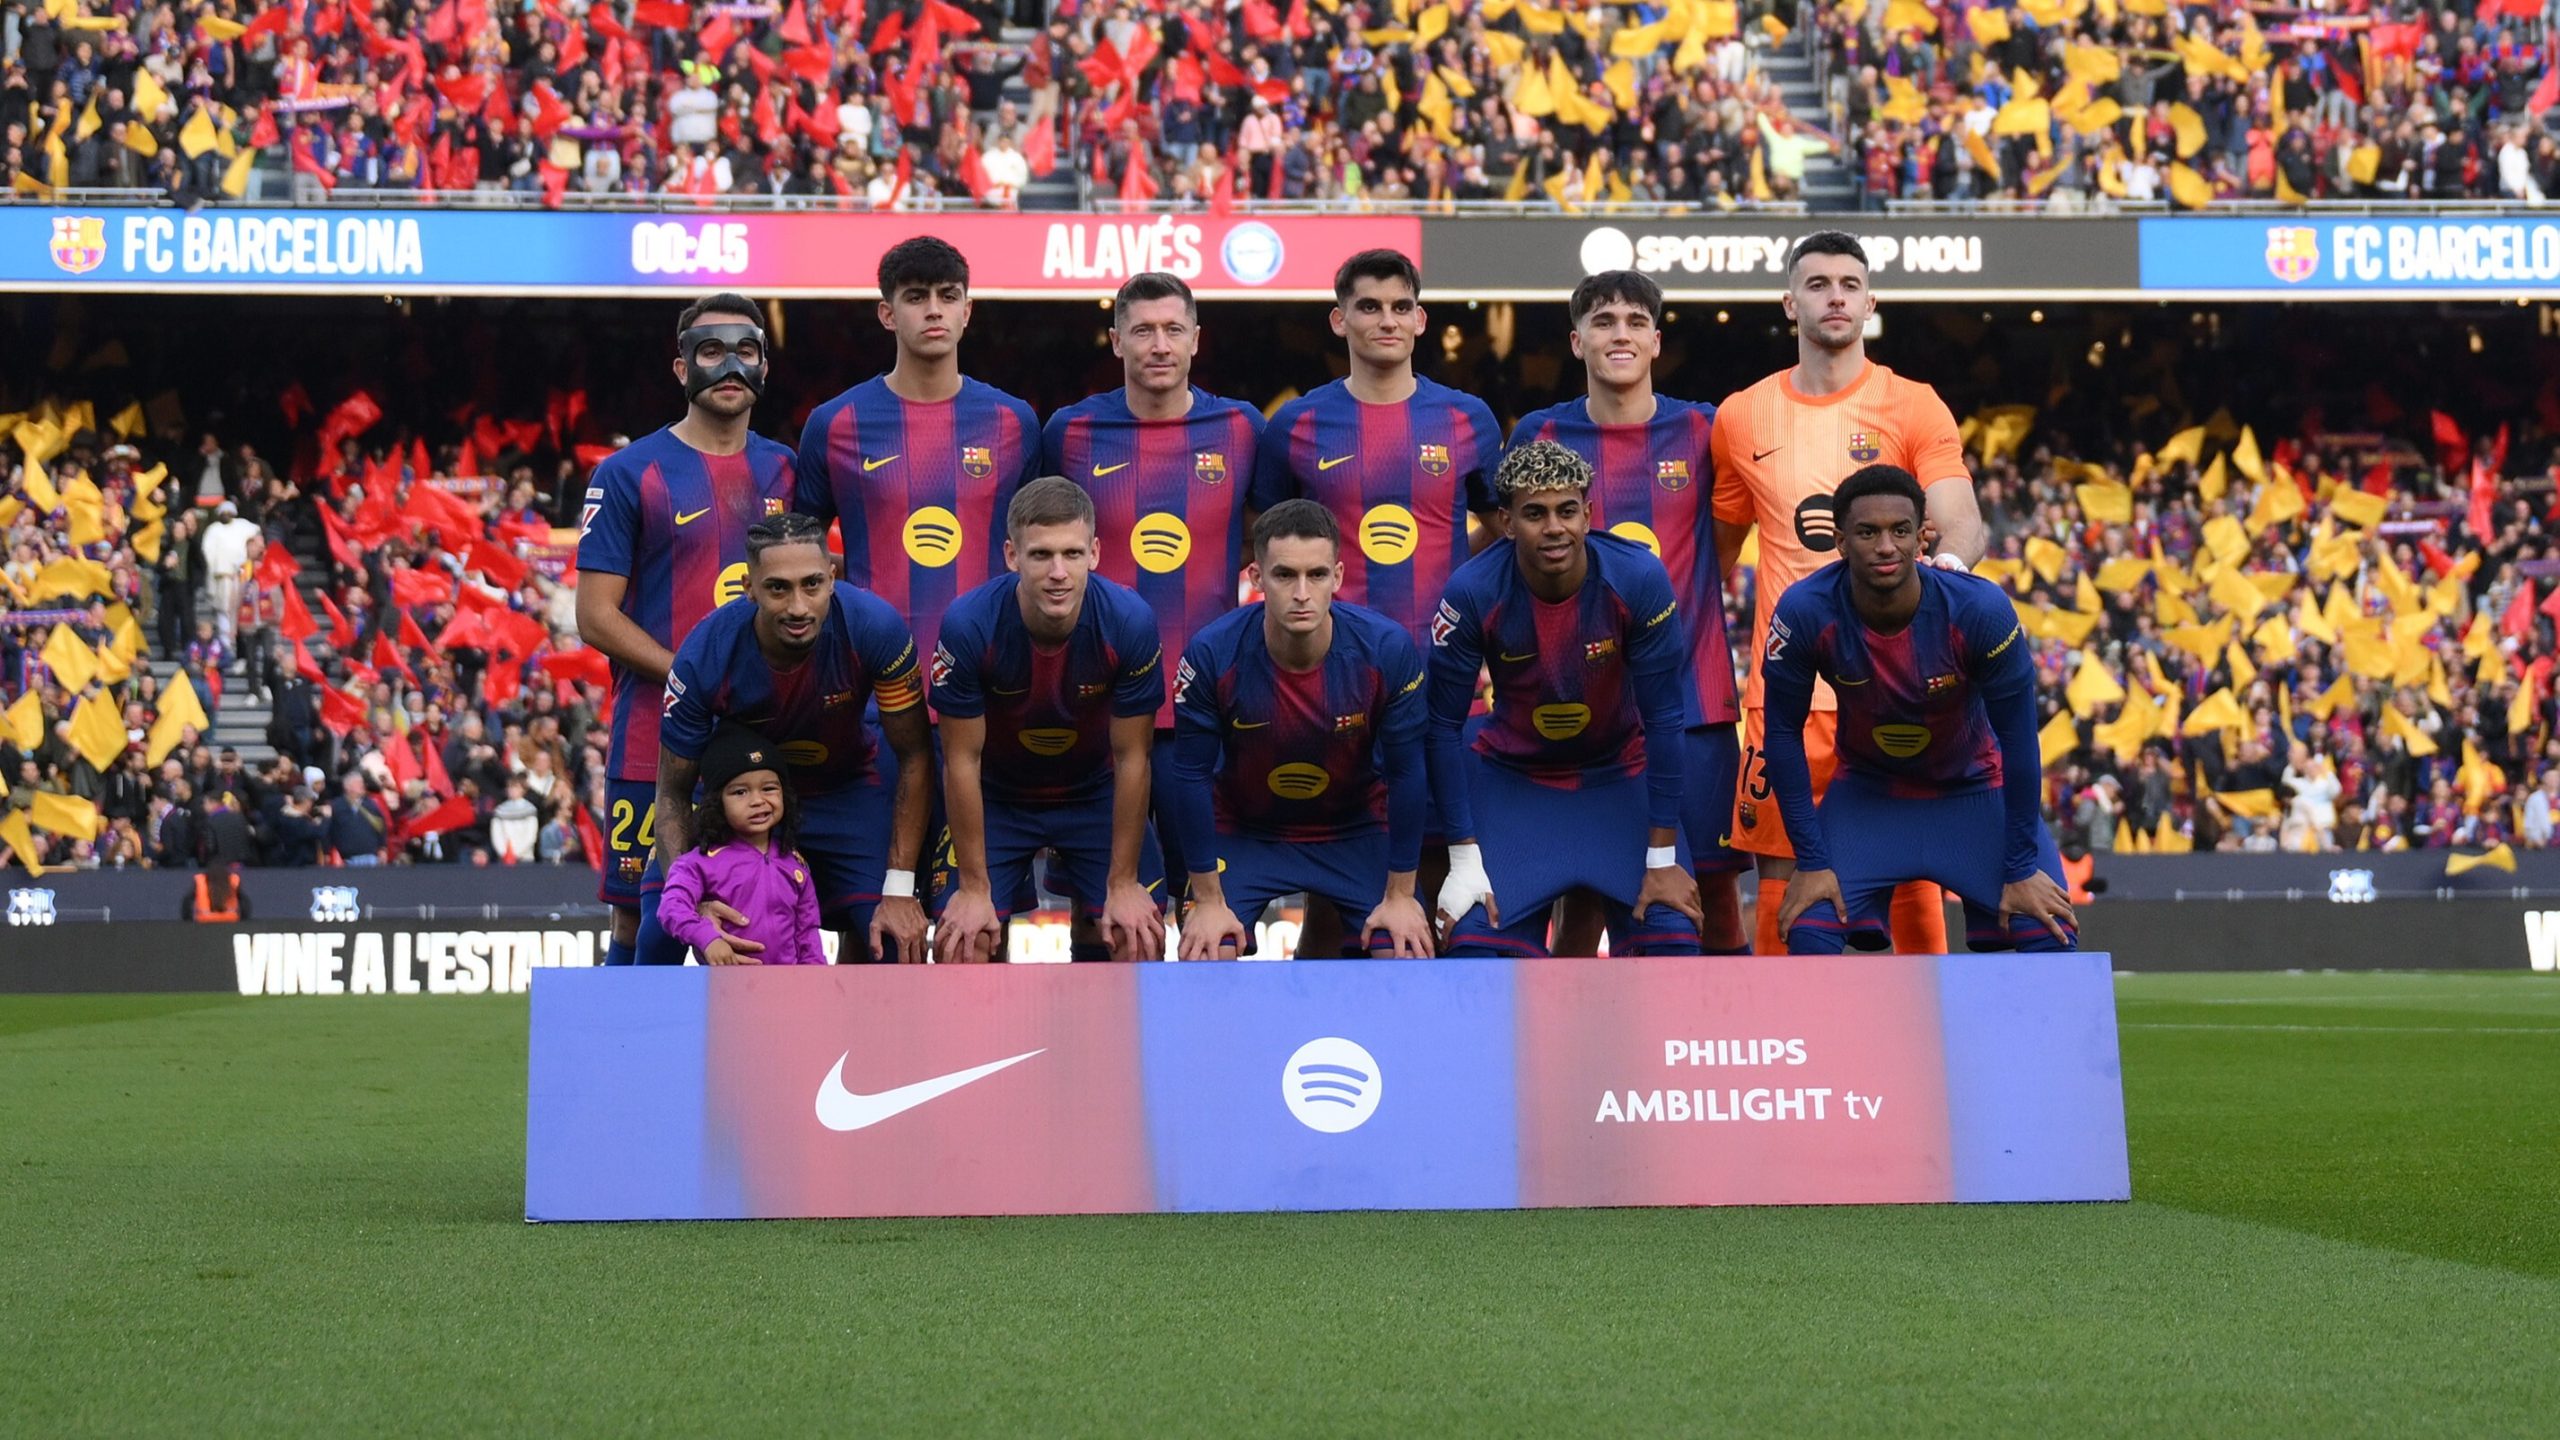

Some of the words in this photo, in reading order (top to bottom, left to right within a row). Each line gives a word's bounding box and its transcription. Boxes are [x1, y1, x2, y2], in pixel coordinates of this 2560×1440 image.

[123, 216, 174, 273] FC
[183, 217, 423, 275] BARCELONA
[631, 222, 748, 273] 00:45
[1043, 215, 1202, 279] ALAVÉS
[1636, 236, 1789, 272] SPOTIFY
[1903, 236, 1982, 272] NOU
[2333, 225, 2382, 280] FC
[2388, 225, 2560, 280] BARCELO
[1741, 745, 1772, 801] 13
[233, 932, 346, 995] VINE
[350, 932, 387, 994] A
[1664, 1038, 1808, 1066] PHILIPS
[1595, 1088, 1832, 1122] AMBILIGHT
[1843, 1090, 1883, 1120] tv
